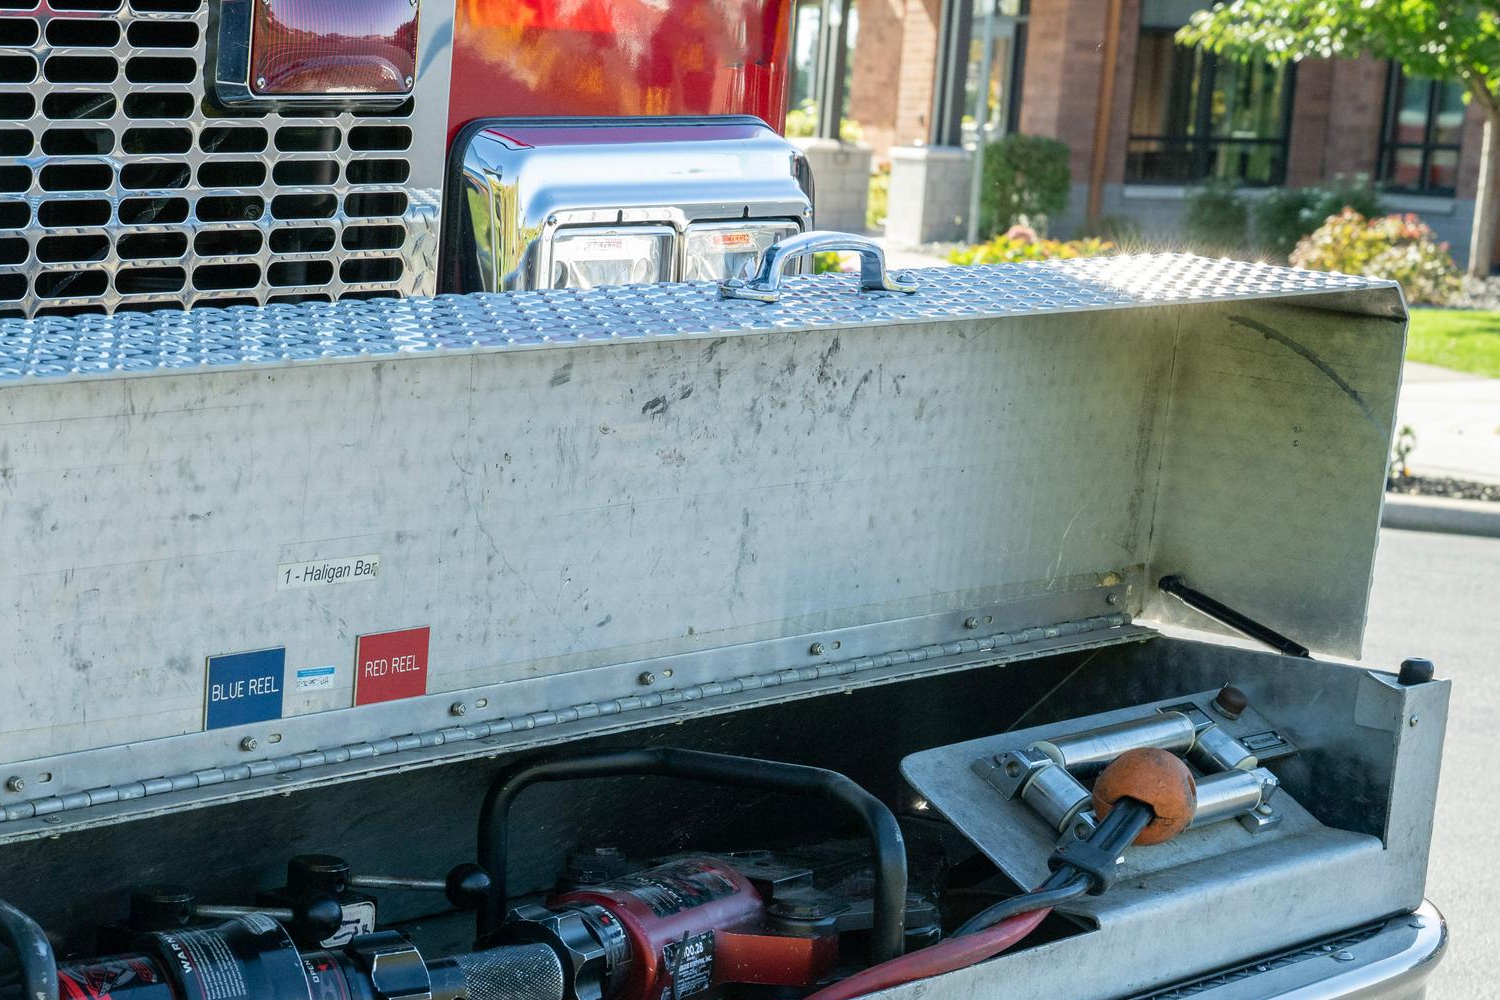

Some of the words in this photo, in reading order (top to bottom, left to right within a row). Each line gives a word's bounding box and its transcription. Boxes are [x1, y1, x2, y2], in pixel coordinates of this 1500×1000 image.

[285, 568, 291, 584] 1
[303, 564, 351, 583] Haligan
[365, 659, 387, 677] RED
[392, 655, 420, 673] REEL
[212, 681, 244, 701] BLUE
[249, 676, 279, 696] REEL
[304, 960, 320, 983] OPEN
